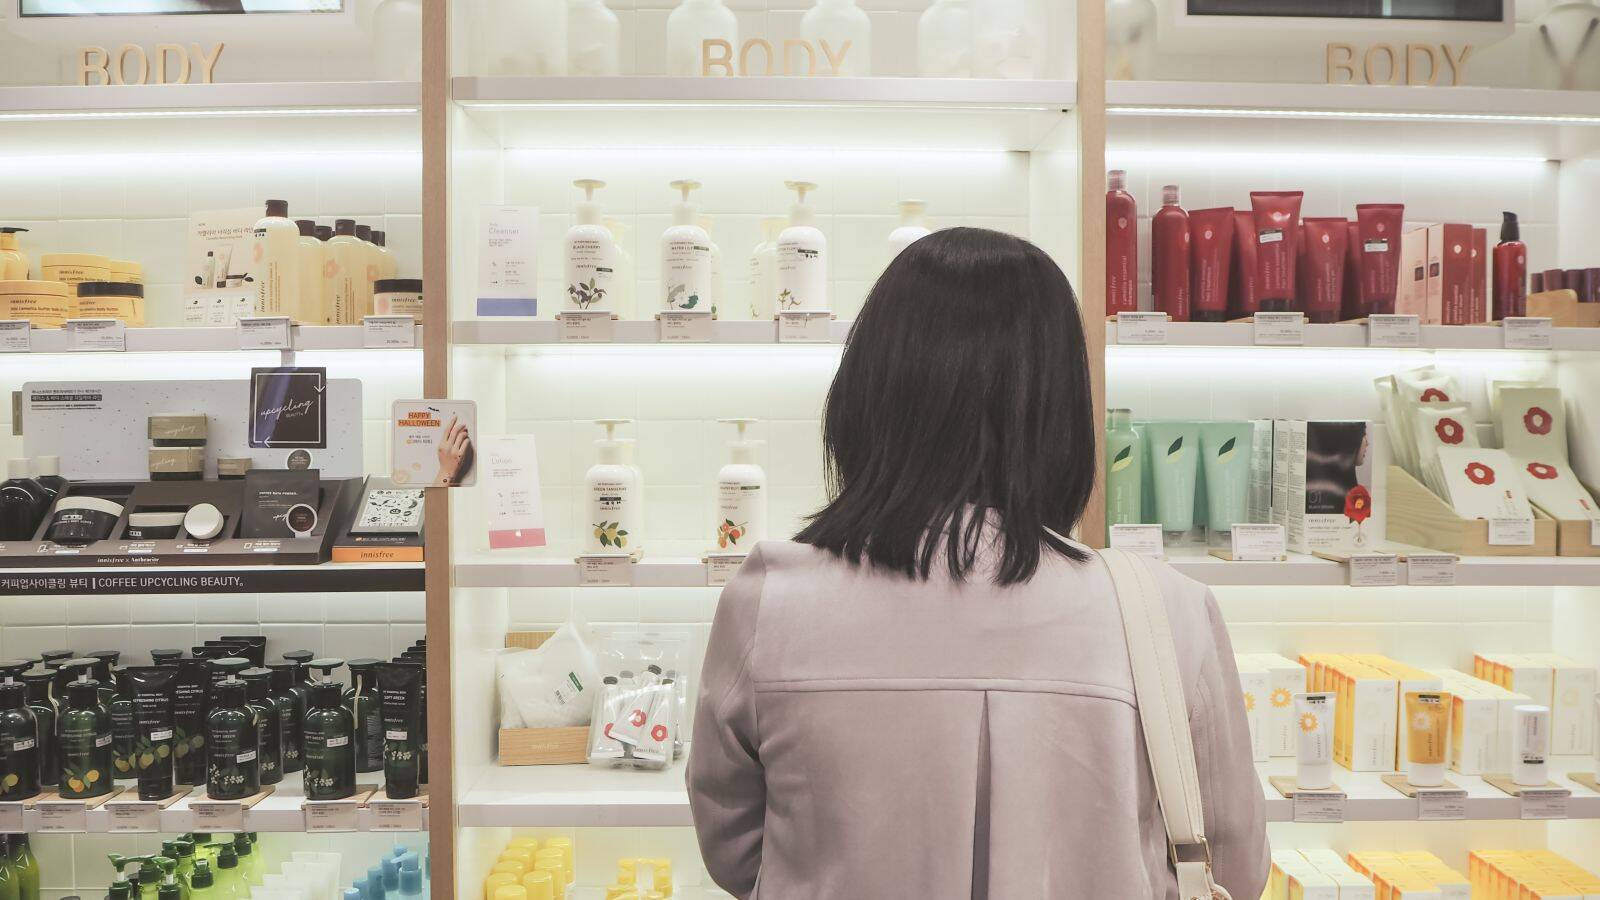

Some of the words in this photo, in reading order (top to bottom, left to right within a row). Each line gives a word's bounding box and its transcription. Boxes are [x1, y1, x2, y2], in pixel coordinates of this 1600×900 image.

[702, 38, 852, 77] BODY
[77, 43, 225, 86] BODY
[1326, 42, 1473, 87] BODY
[488, 227, 519, 235] Cleanser
[260, 399, 315, 421] upcycling
[408, 411, 431, 420] HAPPY
[360, 550, 394, 559] innisfree
[0, 579, 67, 590] 커피업사이클링
[69, 578, 88, 590] 뷰티
[98, 578, 137, 588] COFFEE
[139, 577, 198, 588] UPCYCLING
